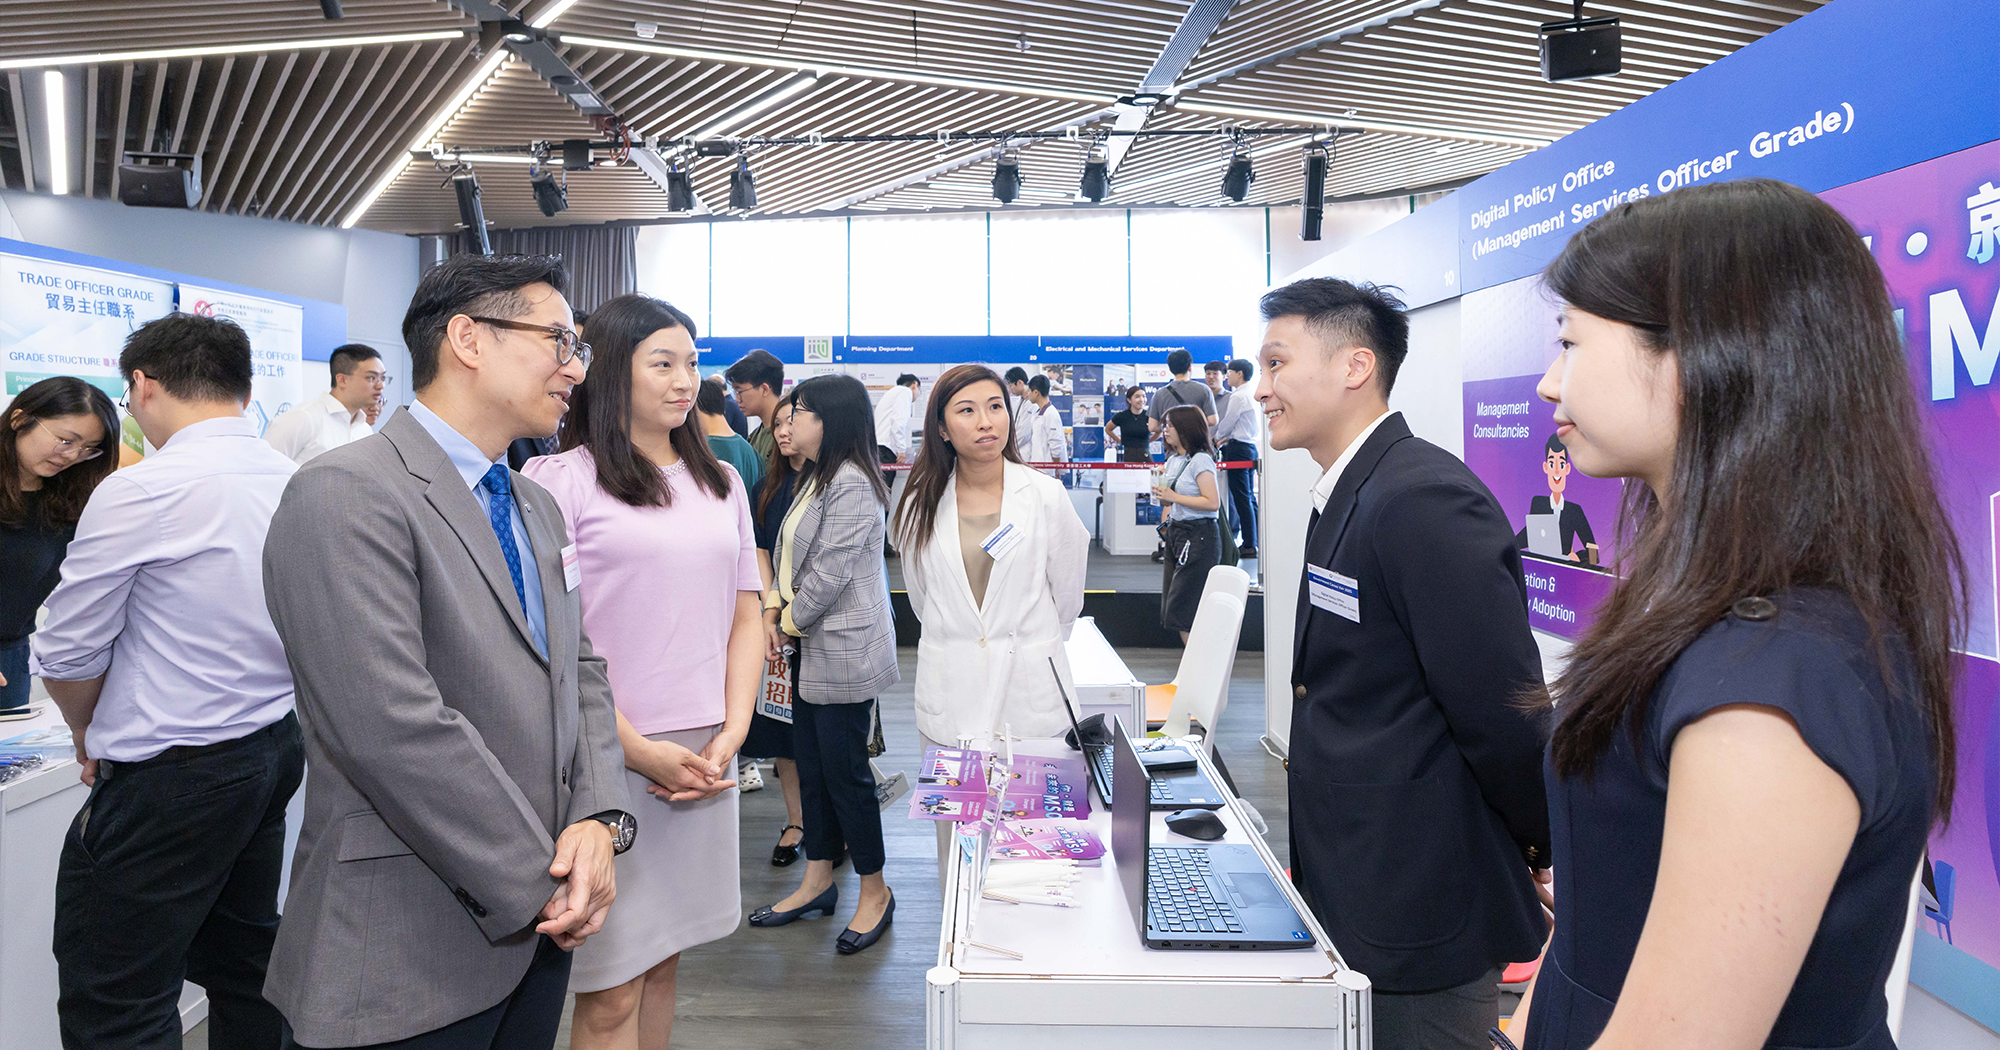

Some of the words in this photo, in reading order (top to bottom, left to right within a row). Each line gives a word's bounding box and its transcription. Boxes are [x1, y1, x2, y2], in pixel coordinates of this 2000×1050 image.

[1472, 210, 1565, 260] (Management
[1571, 183, 1650, 224] Services
[1657, 150, 1739, 193] Officer
[1749, 102, 1855, 159] Grade)
[1471, 199, 1510, 230] Digital
[1514, 183, 1557, 213] Policy
[1562, 160, 1615, 192] Office
[17, 271, 62, 288] TRADE
[65, 279, 115, 297] OFFICER
[117, 287, 155, 302] GRADE
[1444, 269, 1455, 287] 10
[45, 292, 136, 320] 貿易主任職系
[9, 351, 46, 363] GRADE
[47, 354, 101, 367] STRUCTURE
[1477, 400, 1530, 419] Management
[1473, 423, 1530, 438] Consultancies
[1524, 573, 1547, 591] ation
[1548, 576, 1556, 593] &
[1532, 597, 1576, 623] Adoption
[767, 657, 792, 682] 政
[766, 681, 792, 704] 招
